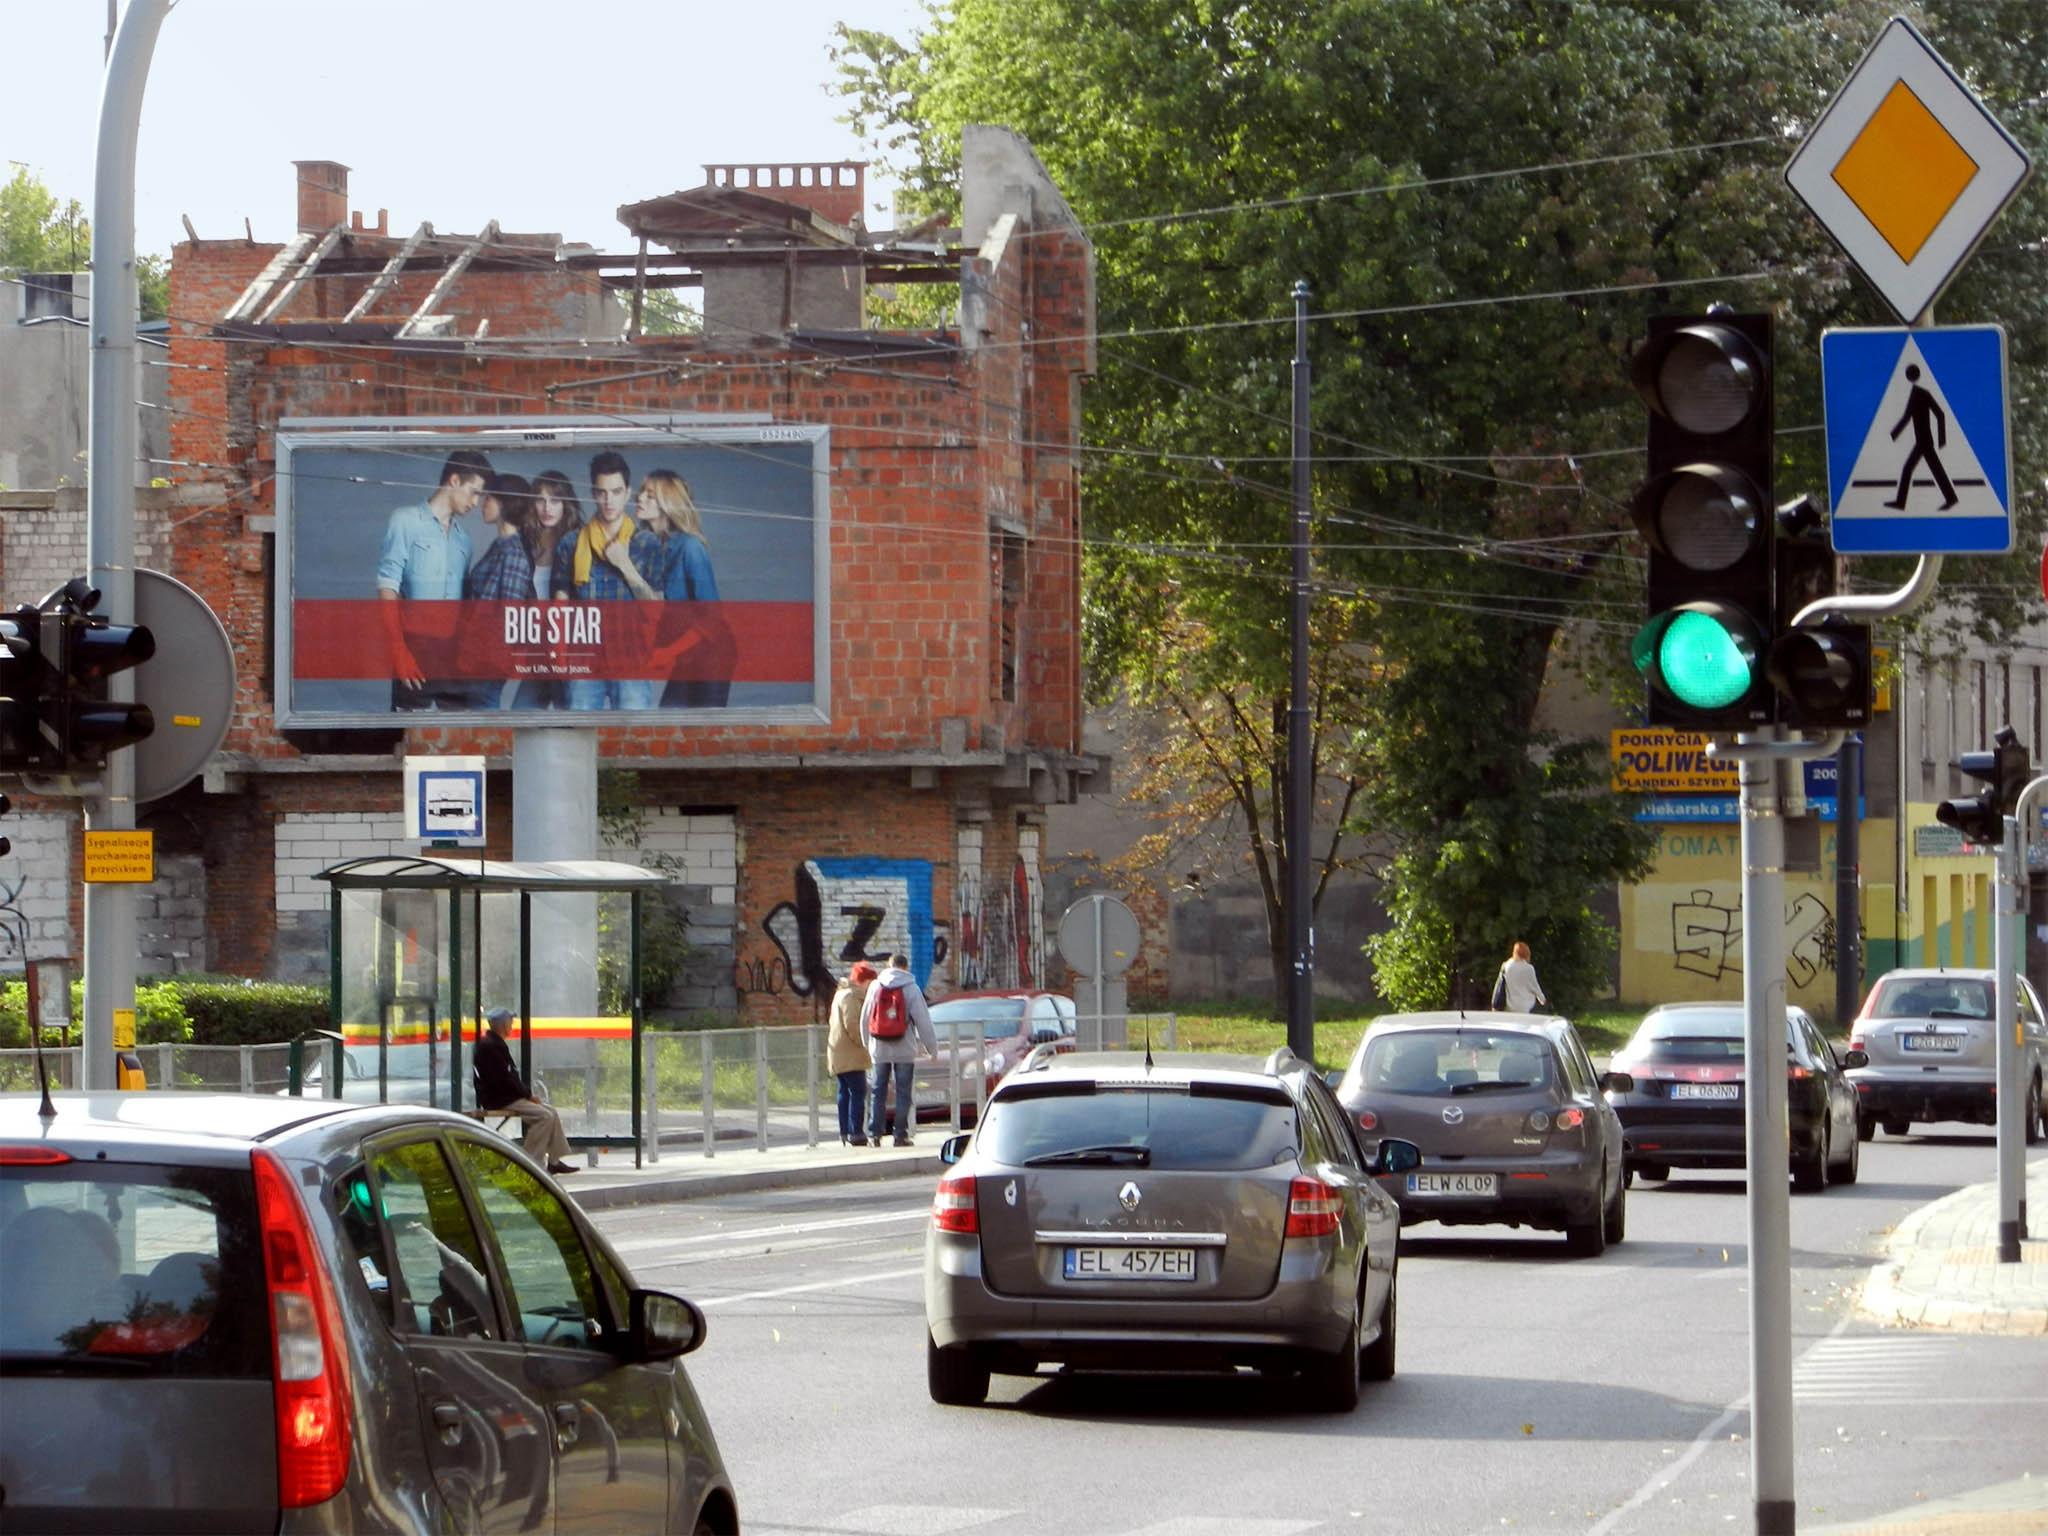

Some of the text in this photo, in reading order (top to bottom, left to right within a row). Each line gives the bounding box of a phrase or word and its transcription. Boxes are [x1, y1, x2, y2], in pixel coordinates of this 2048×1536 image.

[504, 606, 601, 644] BIG STAR
[515, 664, 532, 673] Your
[533, 664, 549, 673] Life.
[551, 664, 568, 673] Your
[1620, 734, 1702, 746] POKRYCIA
[1687, 778, 1726, 787] SZYBY
[1418, 1175, 1492, 1191] ELW 6L09
[1080, 1250, 1191, 1273] EL 457EH
